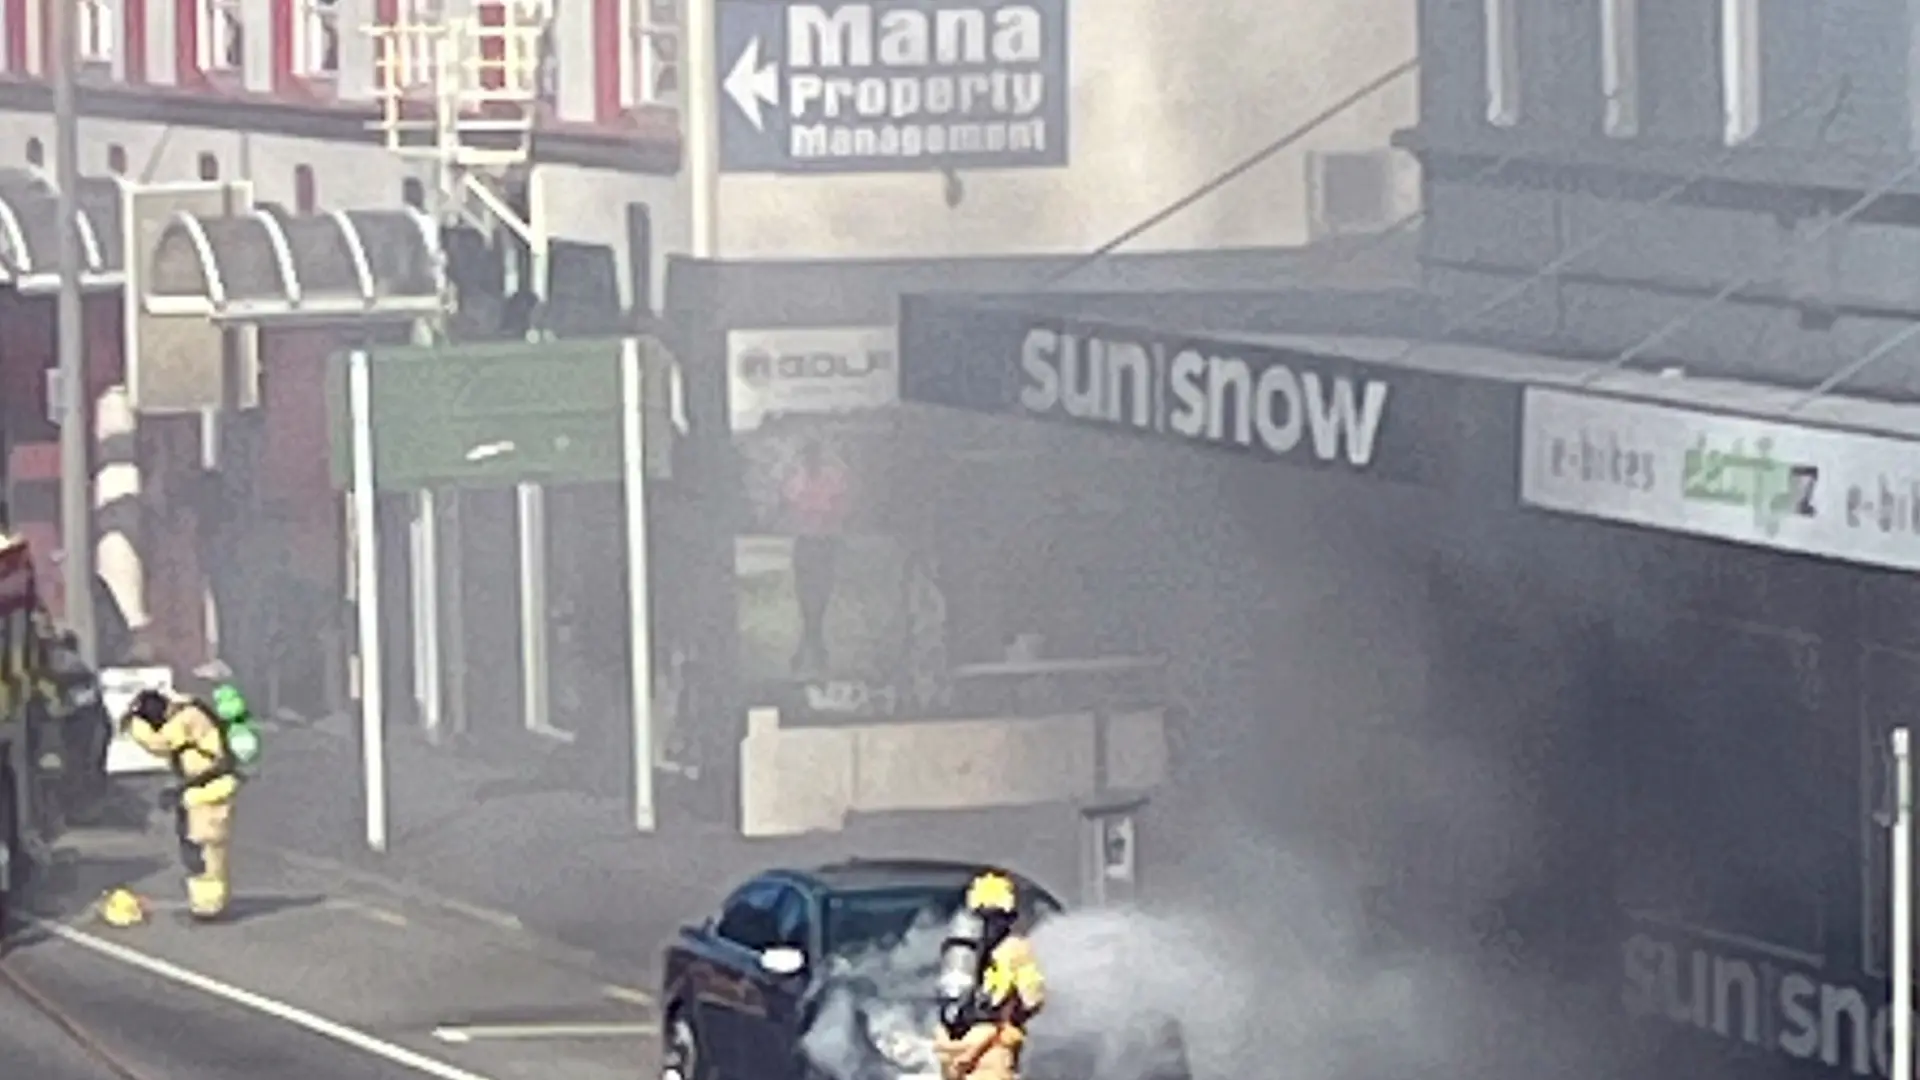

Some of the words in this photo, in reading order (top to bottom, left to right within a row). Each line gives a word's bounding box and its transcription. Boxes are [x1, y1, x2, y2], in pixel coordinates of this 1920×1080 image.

[788, 4, 1041, 67] Mana
[789, 72, 1043, 118] Property
[790, 119, 1045, 157] Management
